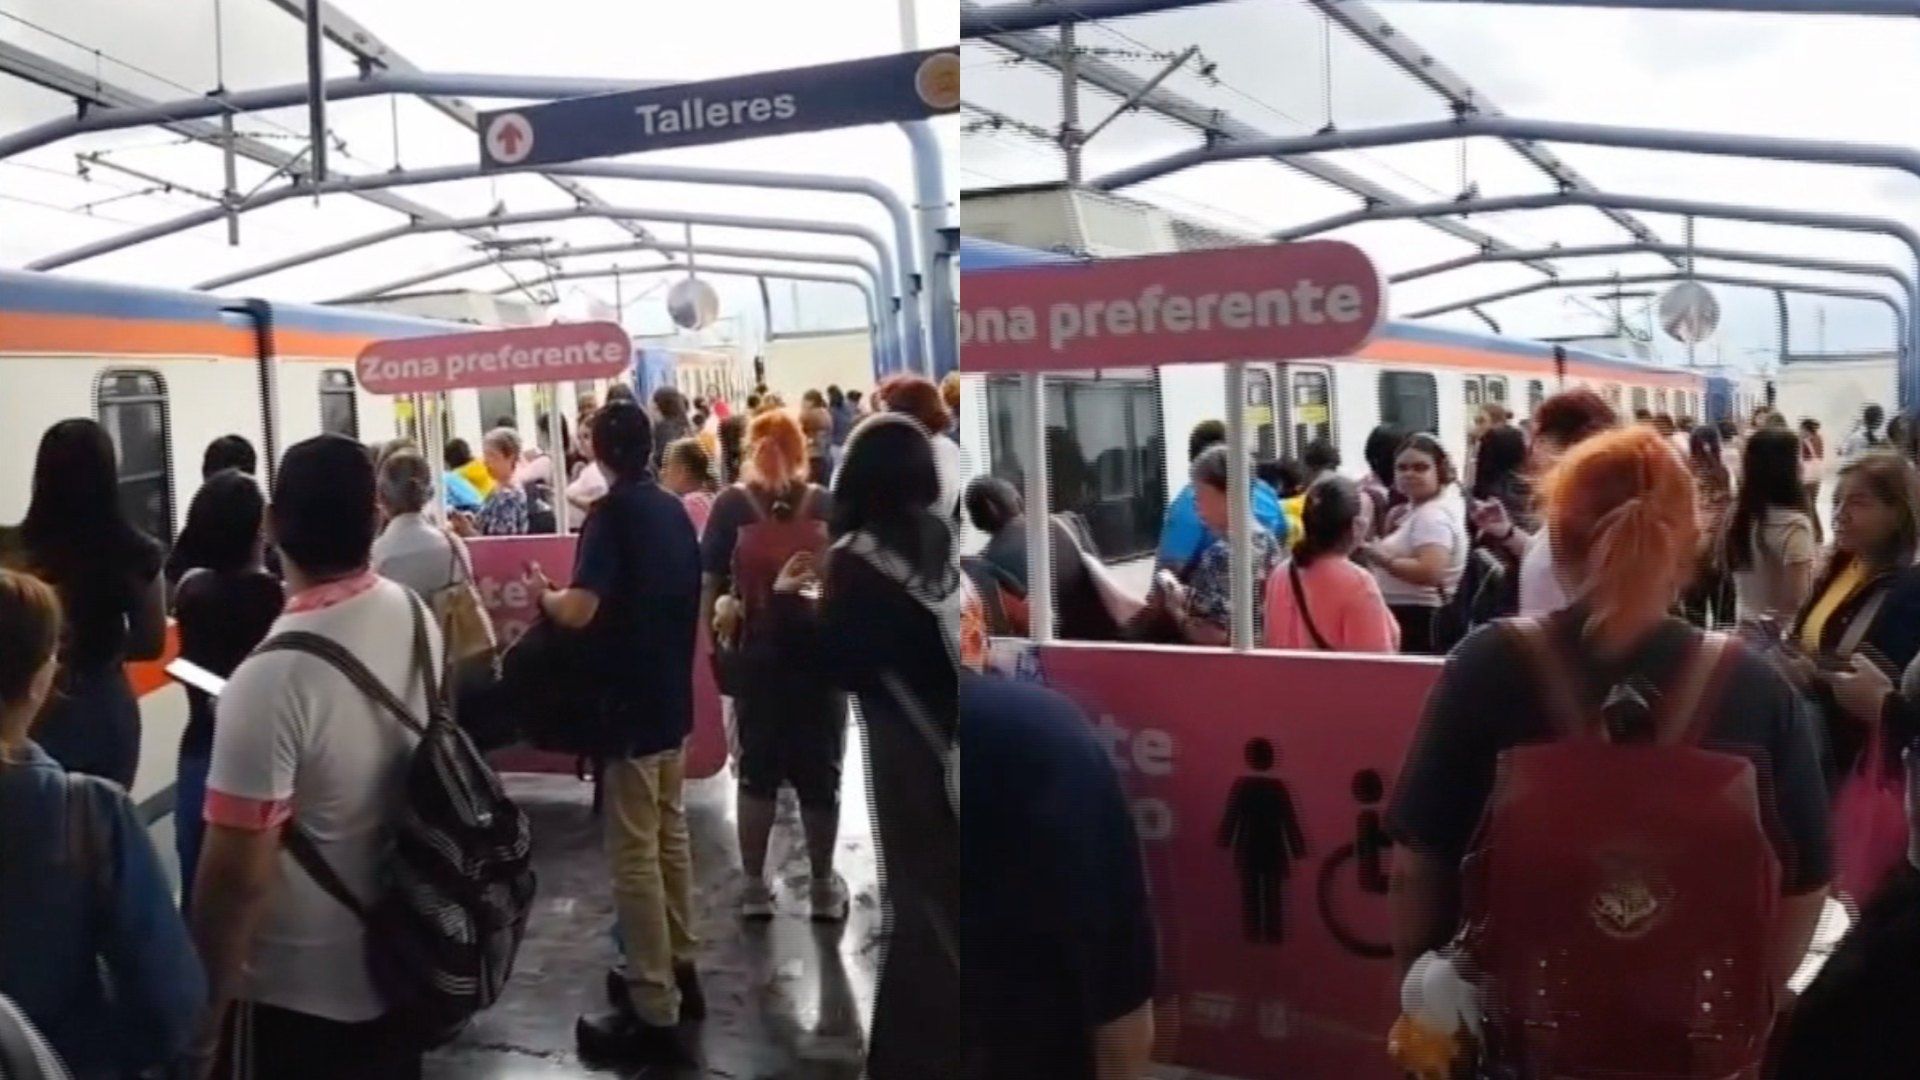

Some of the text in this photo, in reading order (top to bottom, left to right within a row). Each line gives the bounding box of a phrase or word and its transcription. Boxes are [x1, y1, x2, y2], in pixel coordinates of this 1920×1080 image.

[635, 93, 796, 135] Talleres
[1049, 278, 1362, 351] preferente
[361, 339, 623, 381] Zona preferente
